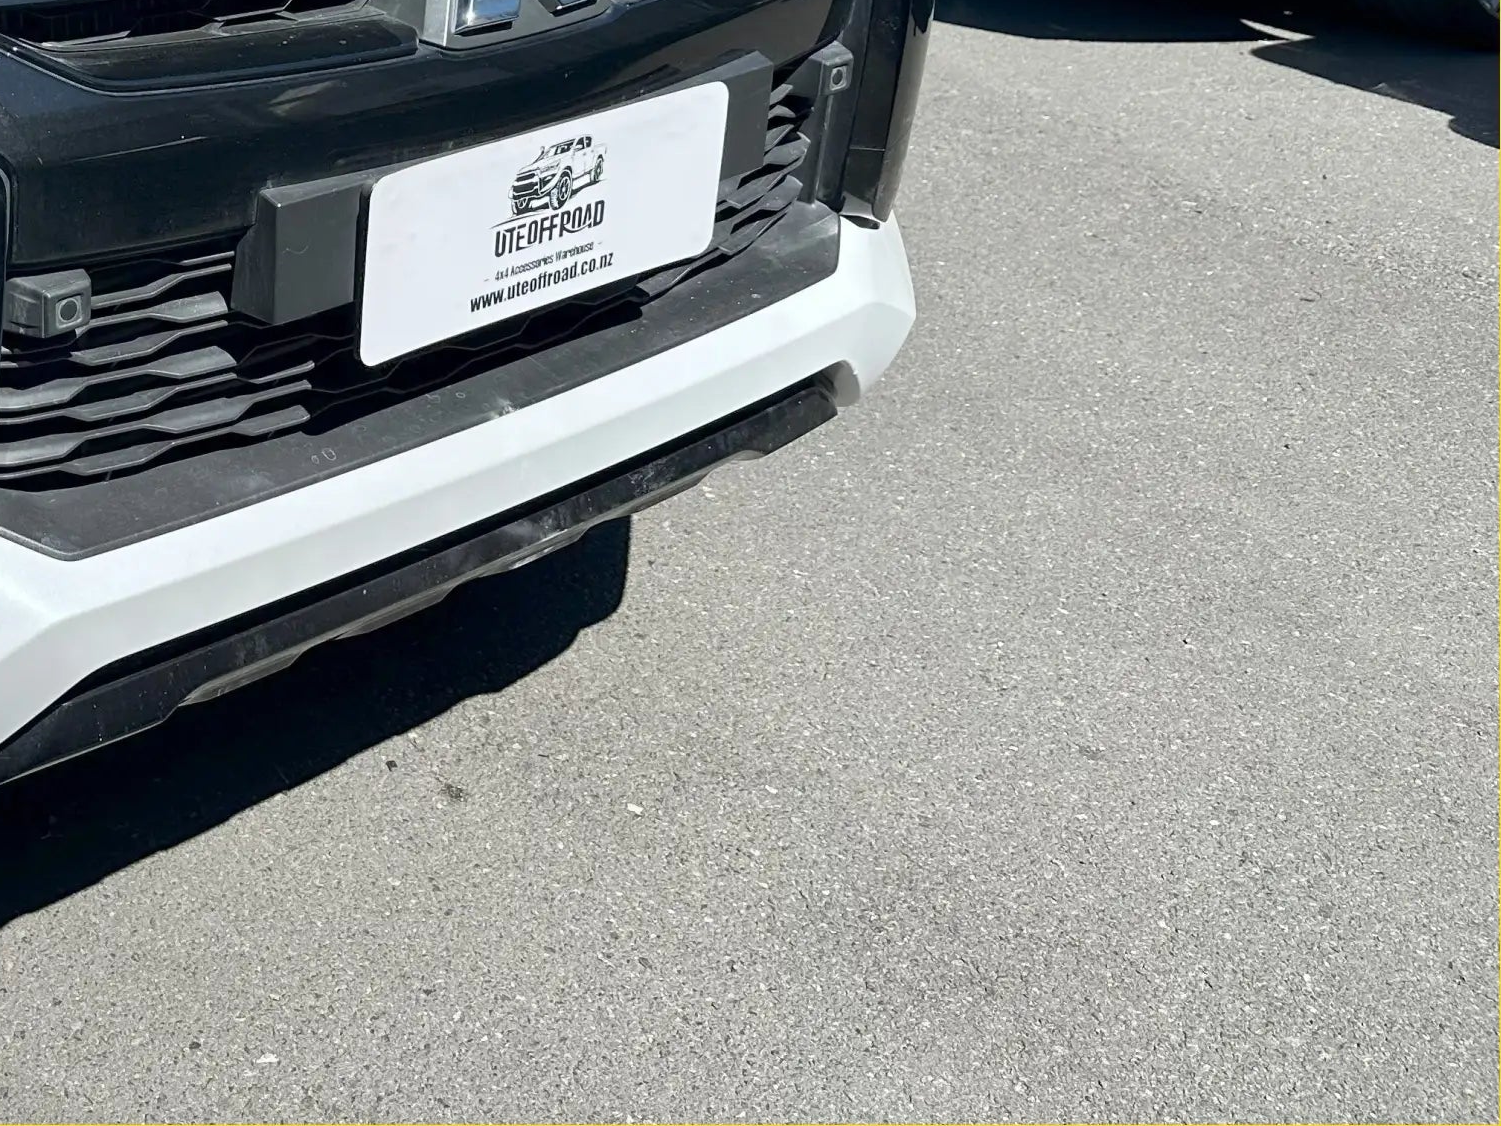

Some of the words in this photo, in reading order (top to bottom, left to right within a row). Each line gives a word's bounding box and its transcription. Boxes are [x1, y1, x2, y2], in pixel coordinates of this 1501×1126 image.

[494, 200, 605, 257] UTEOFFROAD
[470, 252, 614, 312] www.uteoffroad.co.nz
[495, 268, 509, 281] 4x4
[510, 254, 554, 276] Accessories
[555, 241, 594, 262] Warehouse
